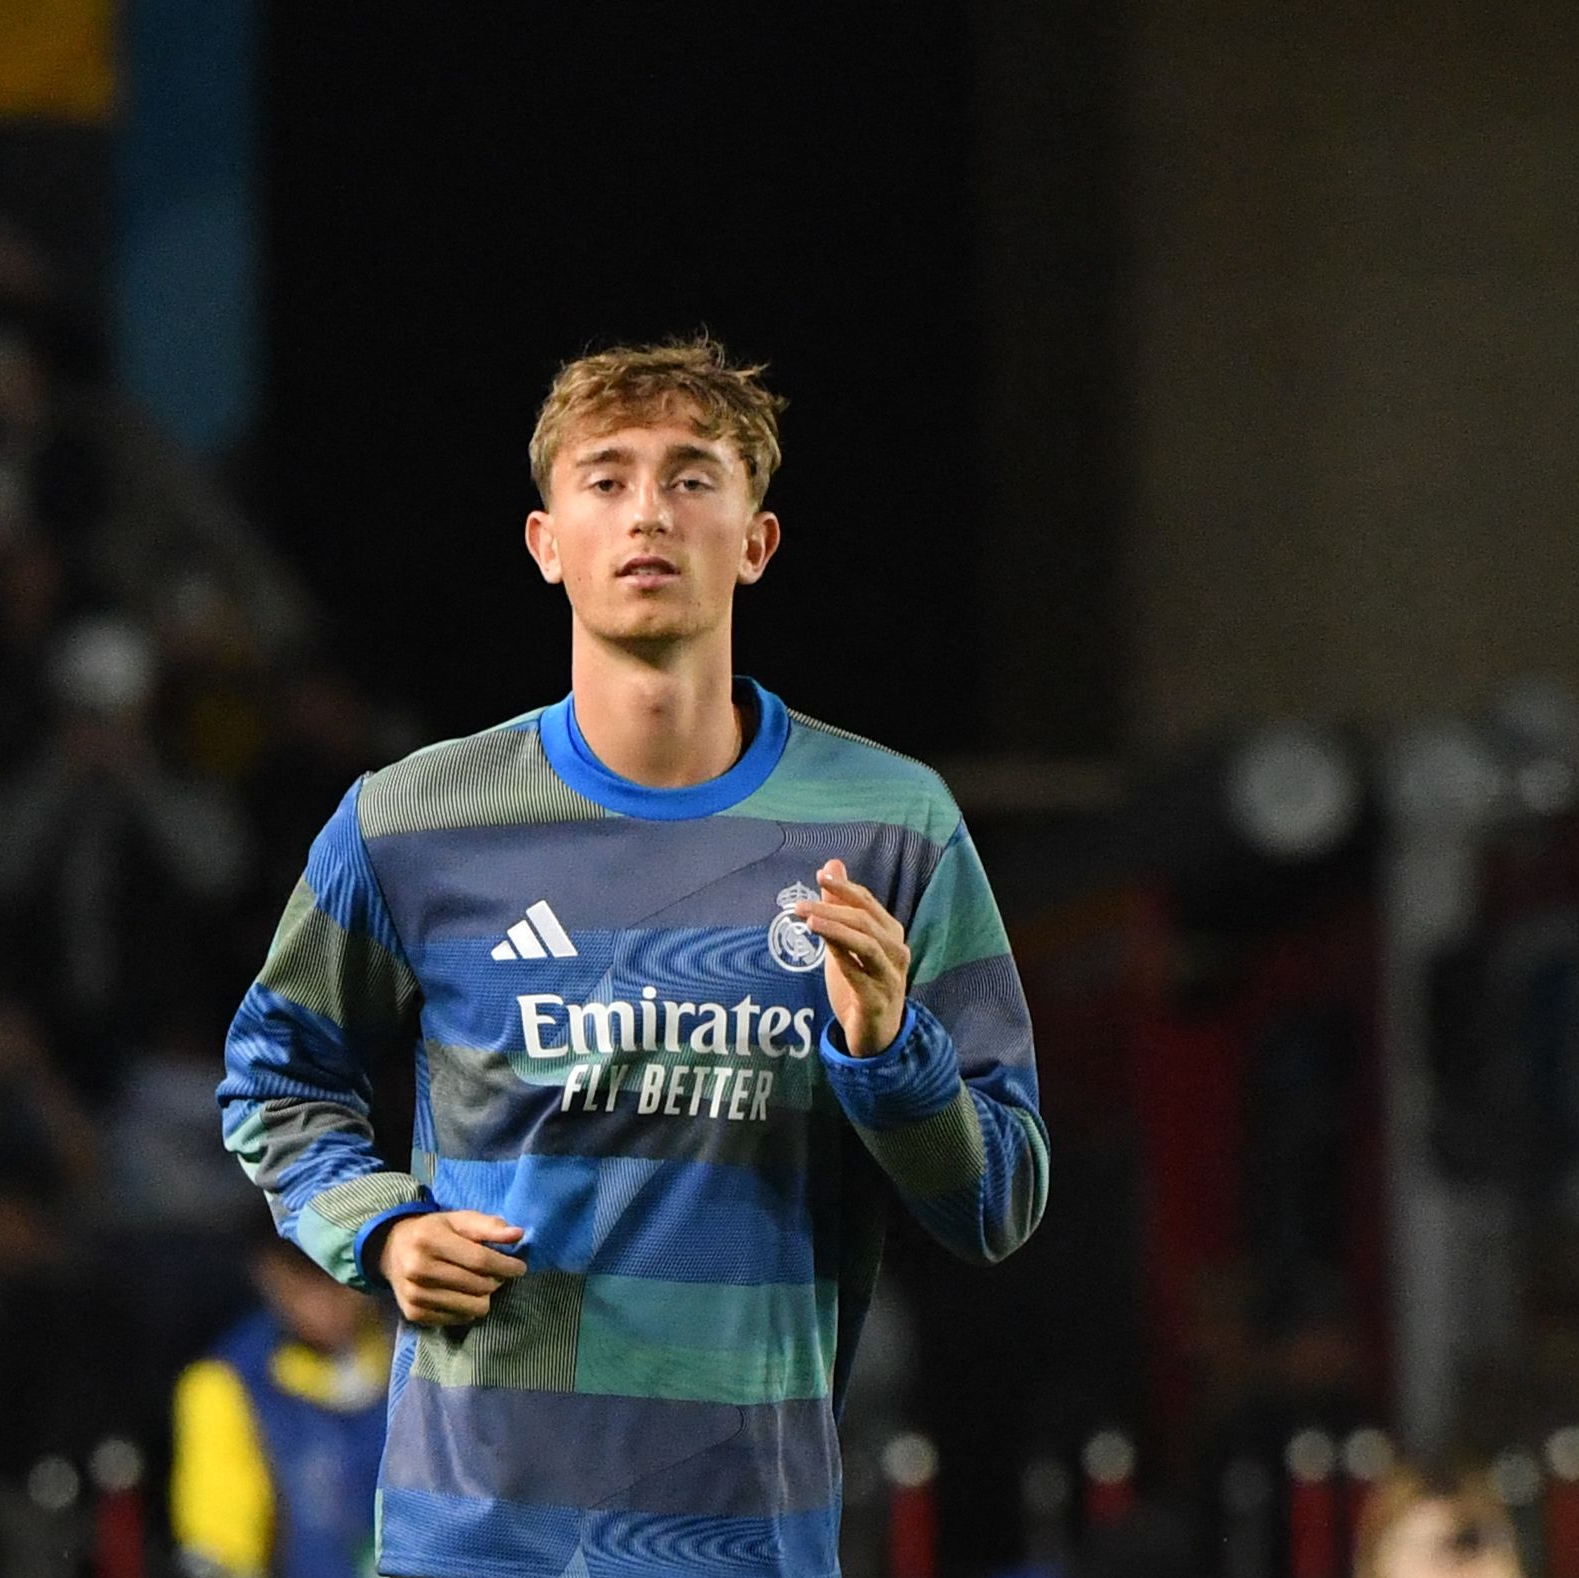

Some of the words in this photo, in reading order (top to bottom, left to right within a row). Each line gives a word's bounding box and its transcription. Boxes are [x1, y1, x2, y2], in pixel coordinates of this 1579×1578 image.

[516, 986, 815, 1060] Emirates
[560, 1064, 625, 1112] FLY
[637, 1064, 774, 1121] BETTER
